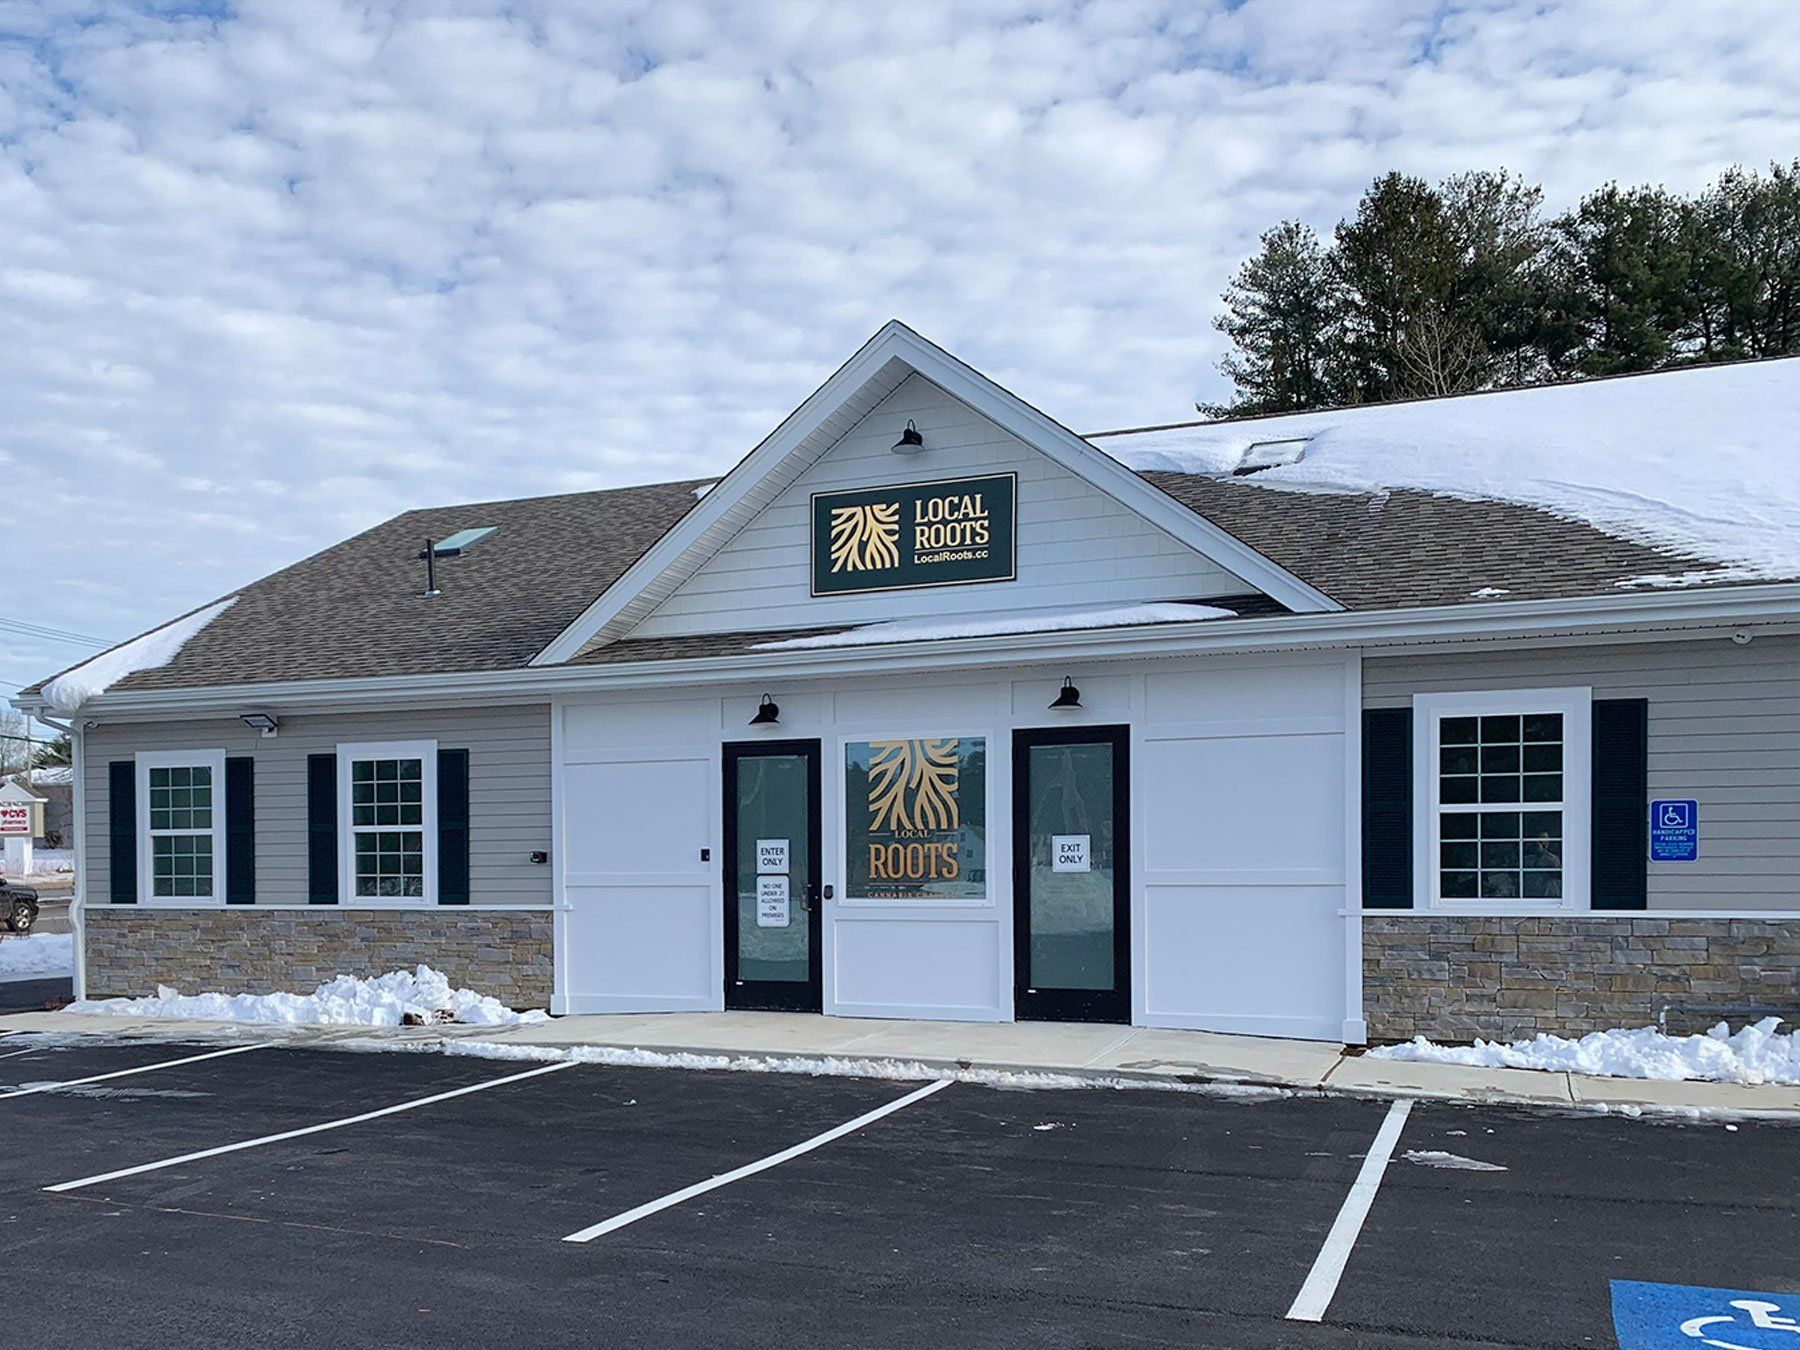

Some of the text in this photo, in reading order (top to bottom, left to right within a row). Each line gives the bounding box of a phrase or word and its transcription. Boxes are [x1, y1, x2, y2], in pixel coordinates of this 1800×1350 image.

[914, 494, 988, 523] LOCAL
[914, 519, 989, 548] ROOTS
[914, 550, 989, 564] LocalRoots.cc
[9, 809, 27, 818] CVS
[894, 829, 931, 838] LOCAL
[761, 847, 785, 856] ENTER
[1061, 843, 1081, 853] EXIT
[762, 858, 783, 866] ONLY
[869, 843, 959, 879] ROOTS
[1059, 854, 1083, 864] ONLY
